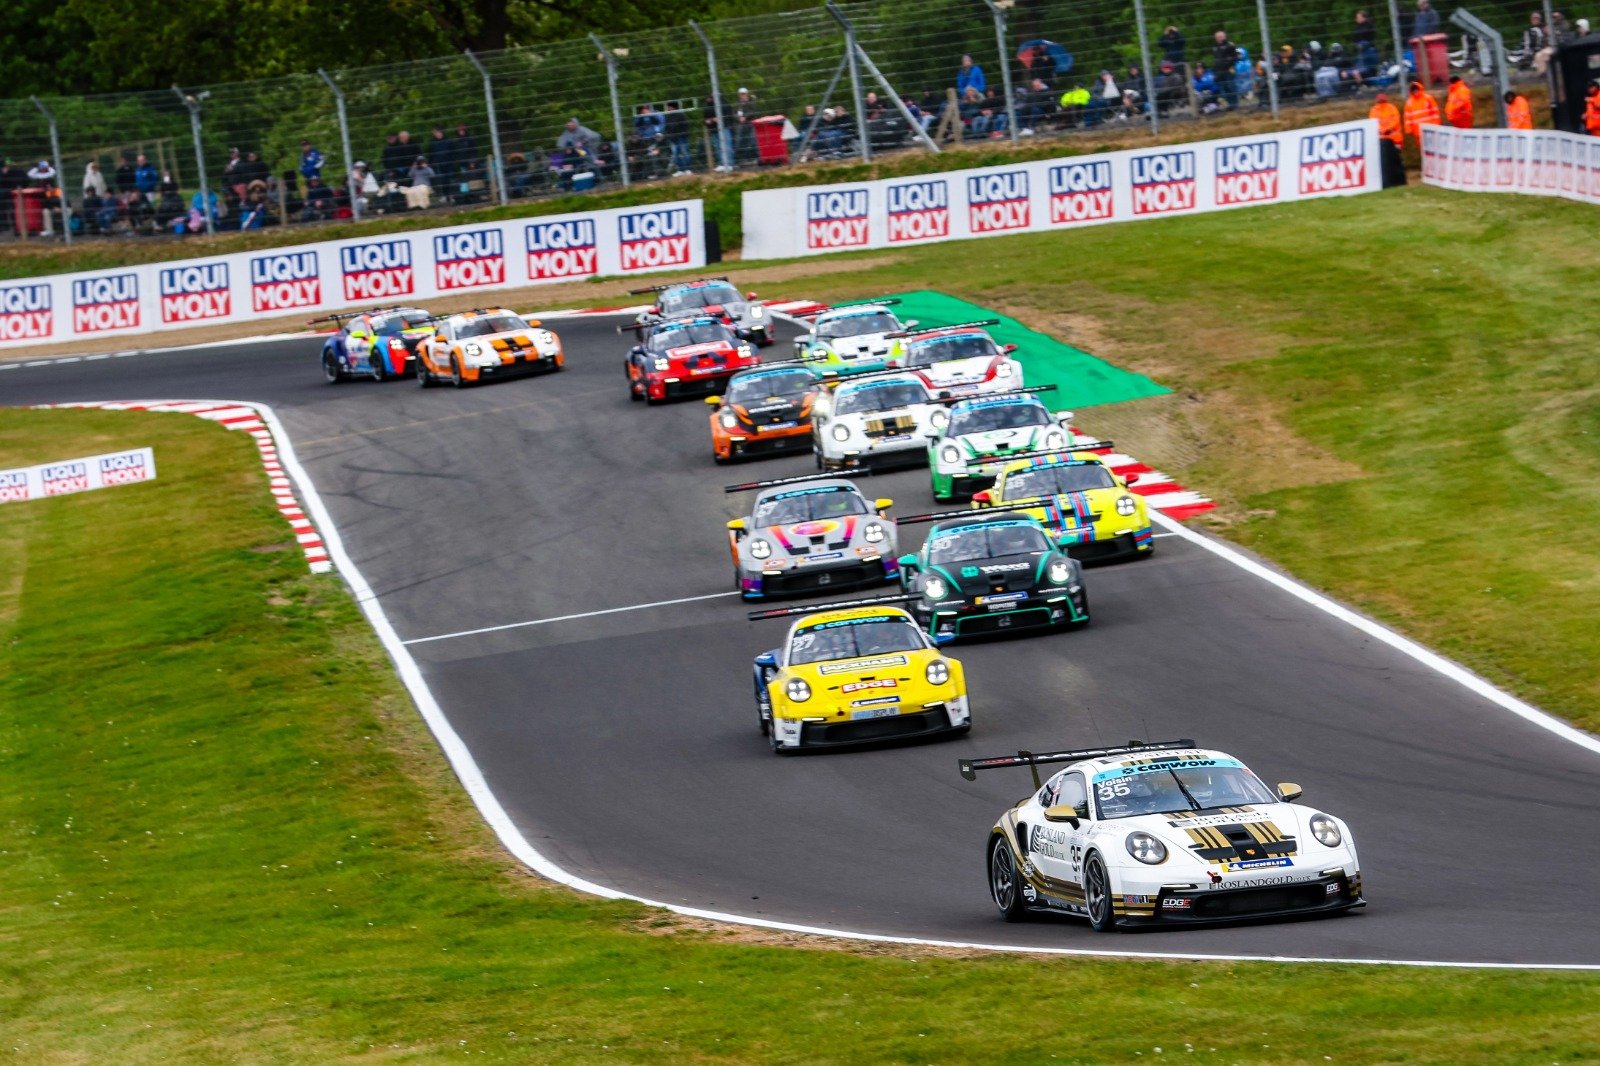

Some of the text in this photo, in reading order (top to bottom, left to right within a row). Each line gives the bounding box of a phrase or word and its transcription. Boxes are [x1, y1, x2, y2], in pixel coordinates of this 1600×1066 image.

[1217, 142, 1278, 174] LIQUI
[1302, 130, 1363, 163] LIQUI
[1051, 162, 1110, 194] LIQUI
[1132, 153, 1194, 184] LIQUI
[1302, 159, 1365, 192] MOLY
[889, 181, 946, 213] LIQUI
[969, 172, 1027, 203] LIQUI
[1134, 181, 1196, 213] MOLY
[1218, 172, 1278, 204] MOLY
[809, 190, 867, 220] LIQUI
[972, 201, 1030, 231] MOLY
[1053, 191, 1112, 222] MOLY
[528, 220, 594, 251] LIQUI
[621, 209, 686, 241] LIQUI
[809, 218, 867, 247] MOLY
[889, 210, 948, 240] MOLY
[343, 240, 410, 272] LIQUI
[436, 230, 501, 262] LIQUI
[623, 237, 688, 270] MOLY
[253, 252, 317, 284] LIQUI
[438, 258, 504, 289] MOLY
[530, 247, 596, 279] MOLY
[75, 275, 136, 305] LIQUI
[163, 264, 228, 295] LIQUI
[345, 268, 412, 300] MOLY
[0, 285, 49, 313] IQUI
[163, 291, 230, 322] MOLY
[255, 280, 319, 311] MOLY
[75, 301, 139, 332] MOLY
[43, 463, 86, 482] LIQUI
[101, 454, 144, 472] LIQUI
[103, 467, 147, 485] MOLY
[0, 473, 26, 488] QUI
[0, 485, 28, 501] OLY
[45, 476, 88, 495] MOLY
[843, 679, 896, 693] EDGE
[1137, 759, 1217, 772] carwow
[1097, 783, 1131, 801] 35
[1241, 859, 1288, 869] MICHELIN
[1162, 897, 1192, 906] EDGE
